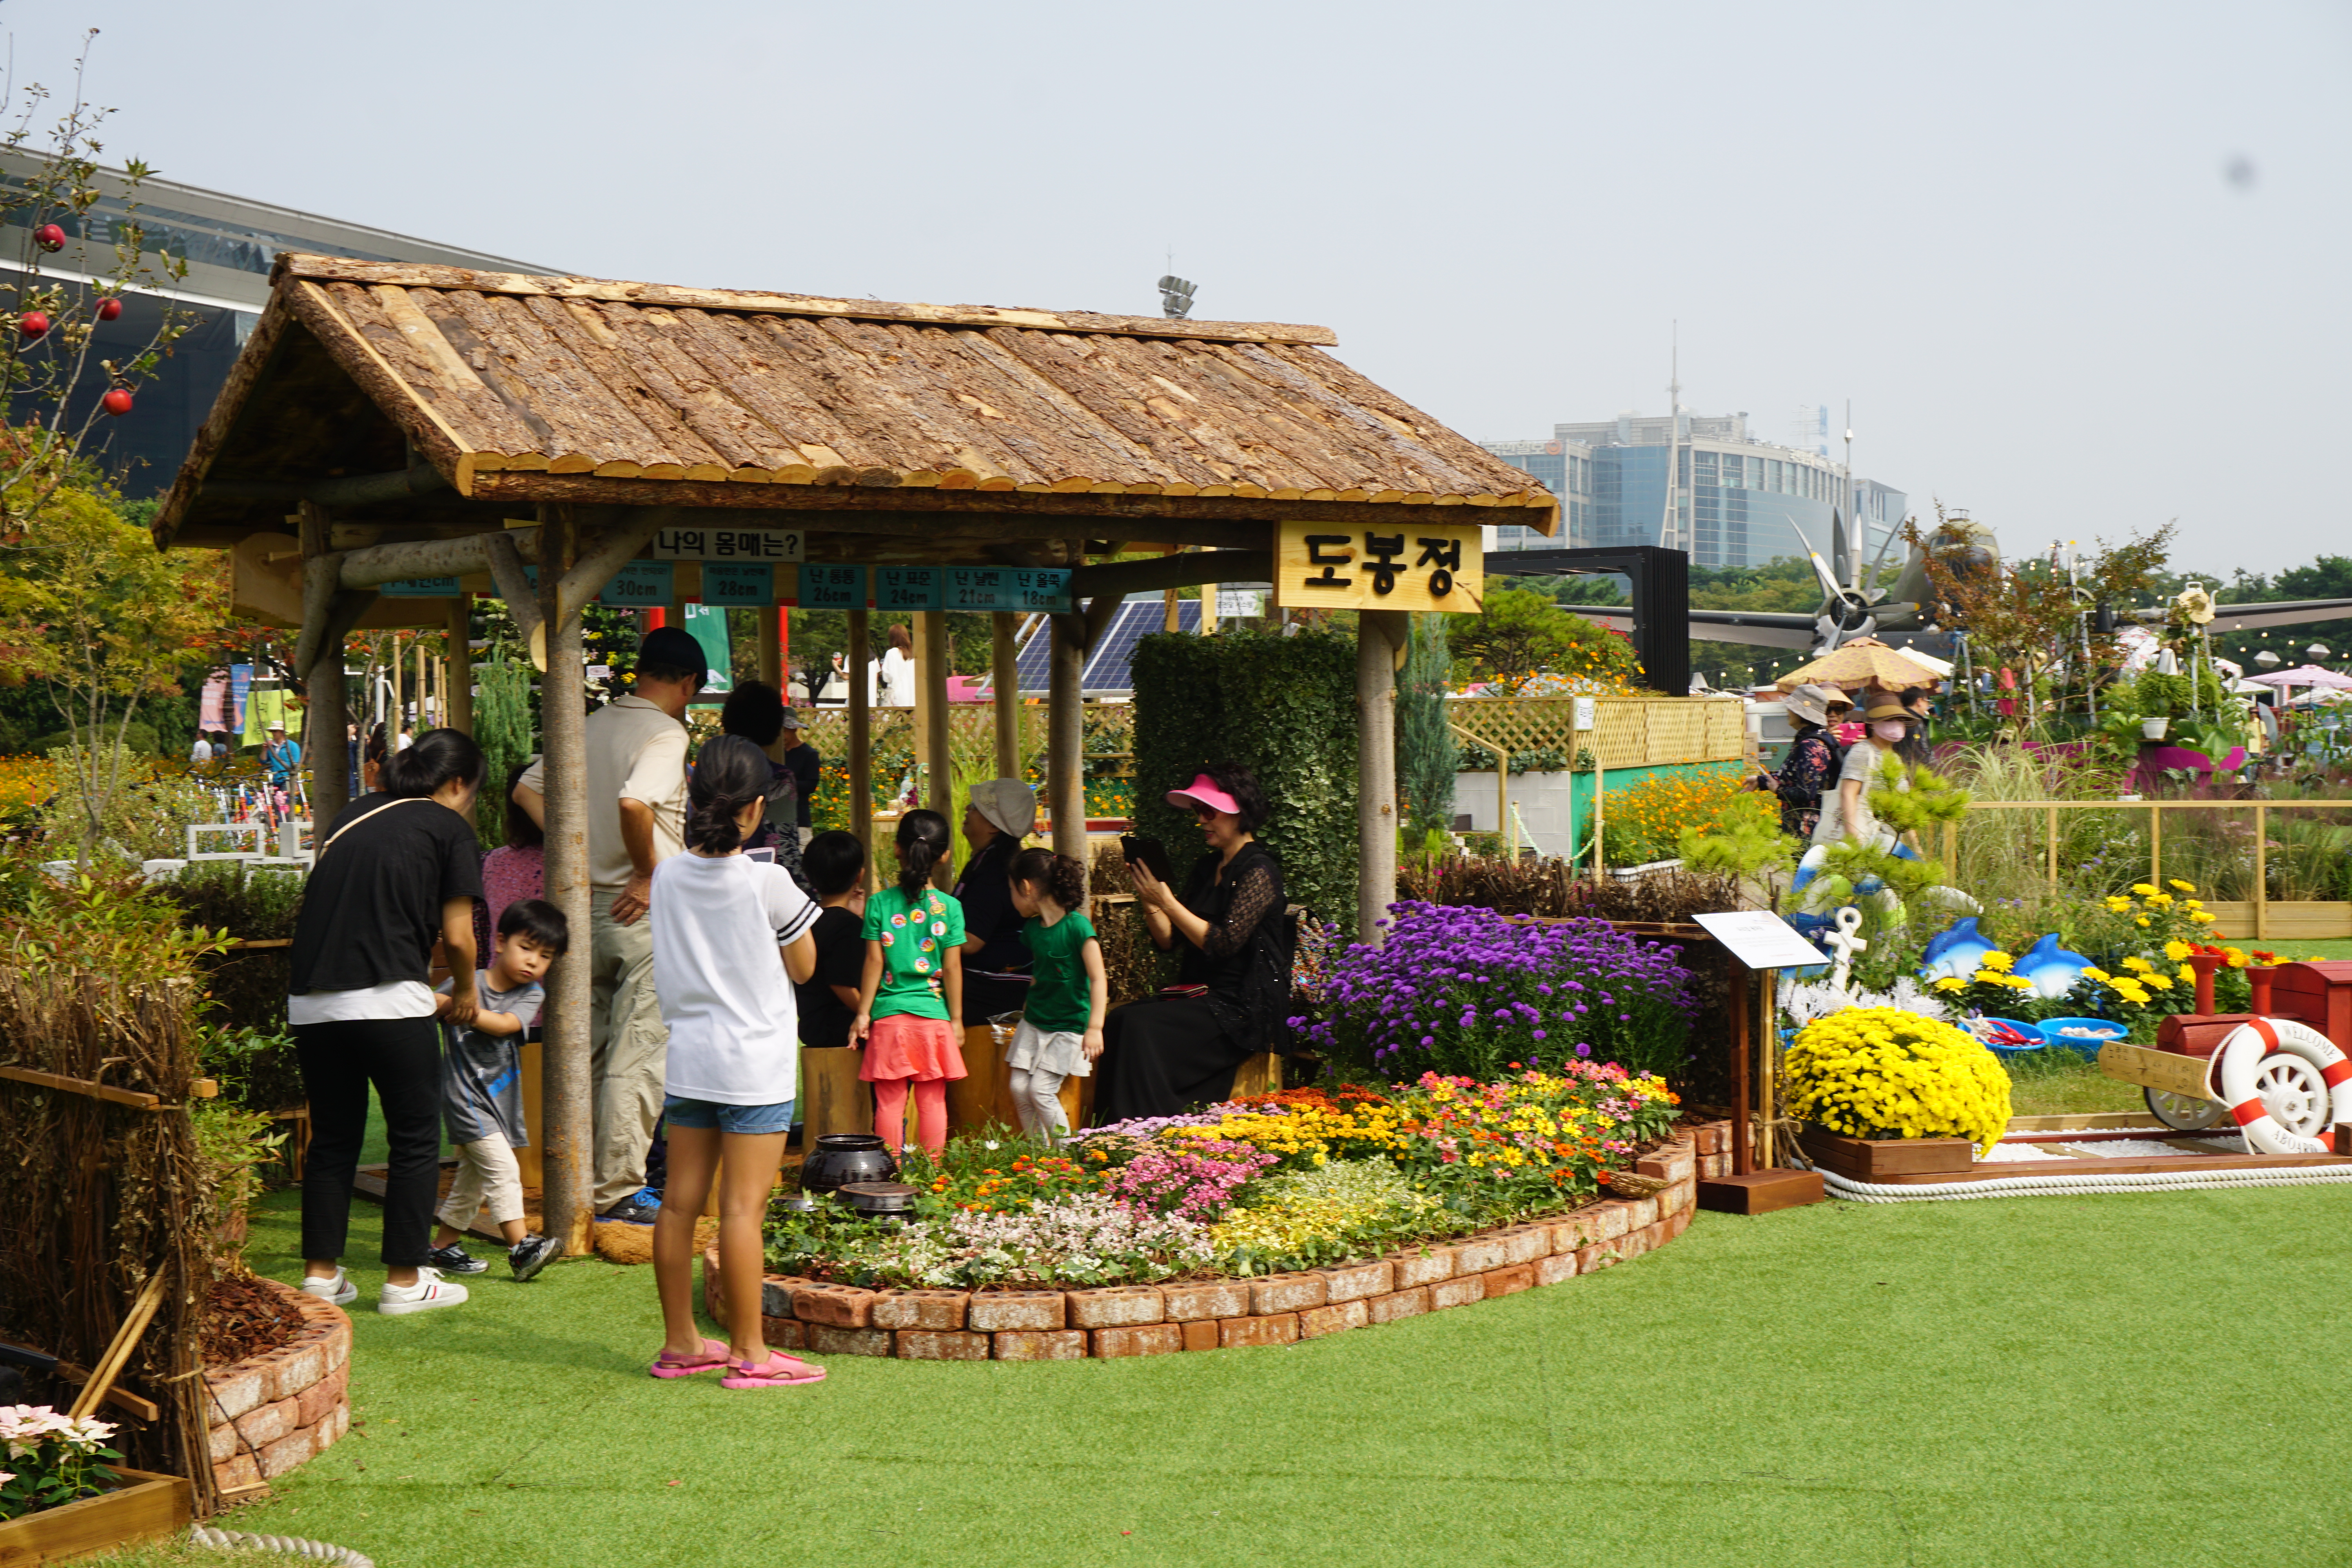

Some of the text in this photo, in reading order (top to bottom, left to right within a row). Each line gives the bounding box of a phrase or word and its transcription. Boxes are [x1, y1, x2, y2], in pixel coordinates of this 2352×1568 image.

[659, 530, 799, 557] 나의 몸매는?
[1305, 532, 1461, 596] 도봉정
[809, 568, 855, 584] 난 통통
[886, 571, 931, 586] 난 표준
[955, 571, 999, 586] 난 날씬
[1018, 573, 1060, 588] 난 홀쭉
[617, 580, 657, 596] 30cm
[718, 580, 757, 596] 28cm
[814, 586, 851, 602] 26cm
[891, 589, 928, 604] 24cm
[959, 589, 996, 604] 21cm
[1022, 590, 1056, 605] 18cm
[2282, 1025, 2337, 1059] WELCOME
[2271, 1130, 2318, 1153] ABOARD
